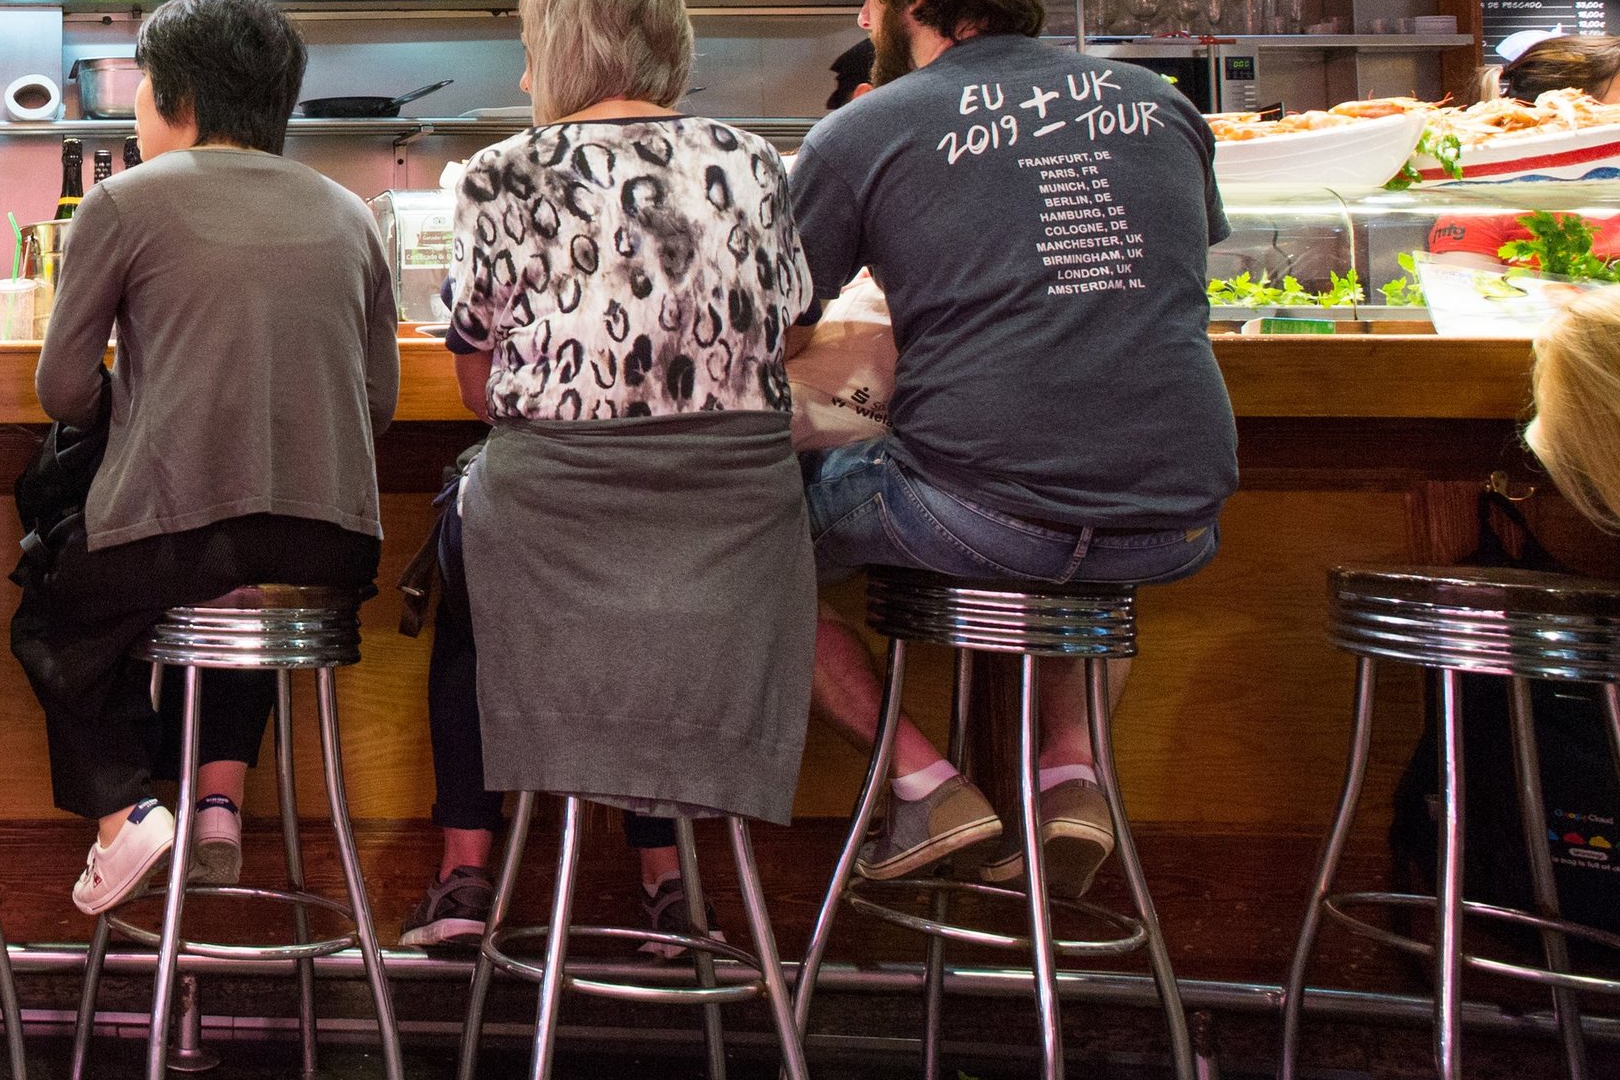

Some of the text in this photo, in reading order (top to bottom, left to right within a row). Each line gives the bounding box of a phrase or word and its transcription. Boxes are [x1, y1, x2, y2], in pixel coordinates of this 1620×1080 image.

[959, 83, 1004, 115] EU
[1067, 70, 1122, 101] UK
[936, 115, 1018, 165] 2019
[1075, 102, 1165, 141] TOUR
[1017, 151, 1112, 168] FRANKFURT, DE
[1040, 165, 1099, 180] PARIS, FR
[1038, 178, 1110, 194] MUNICH, DE
[1045, 192, 1113, 208] BERLIN, DE
[1040, 205, 1126, 222] HAMBURG, DE
[1045, 220, 1129, 237] COLOGNE, DE
[1036, 233, 1144, 253] MANCHESTER, UK
[1042, 248, 1144, 266] BIRMINGHAM, UK
[1057, 263, 1132, 280] LONDON, UK
[1047, 278, 1146, 296] AMSTERDAM, NL
